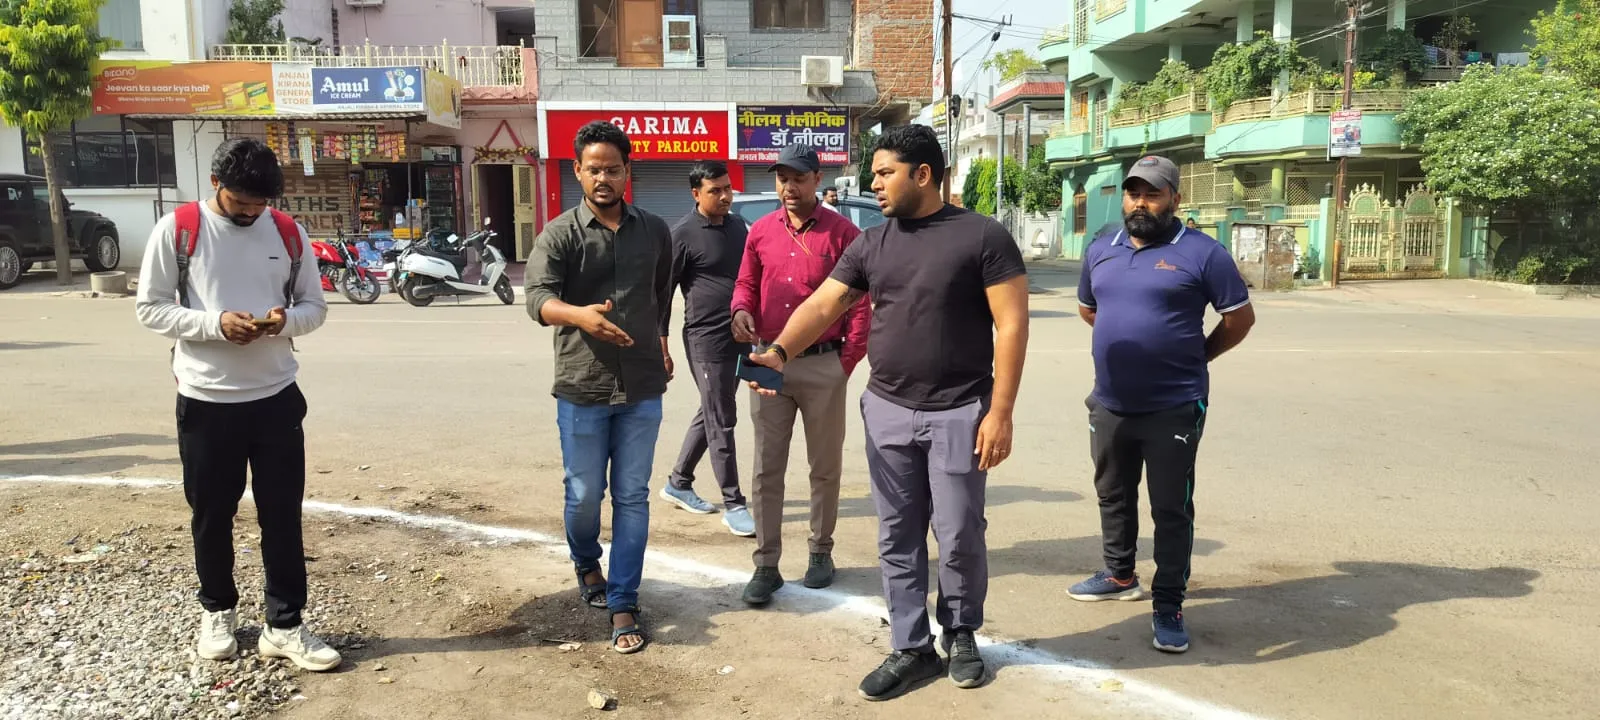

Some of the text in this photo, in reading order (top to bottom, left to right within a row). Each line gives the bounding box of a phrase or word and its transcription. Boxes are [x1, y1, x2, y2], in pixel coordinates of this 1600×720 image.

[106, 84, 138, 92] Jeevan
[139, 84, 151, 92] ka
[173, 84, 191, 95] kya
[320, 76, 370, 94] Amul
[610, 116, 708, 135] GARIMA
[738, 111, 846, 127] नीलम क्लीनिक
[657, 141, 719, 153] PARLOUR
